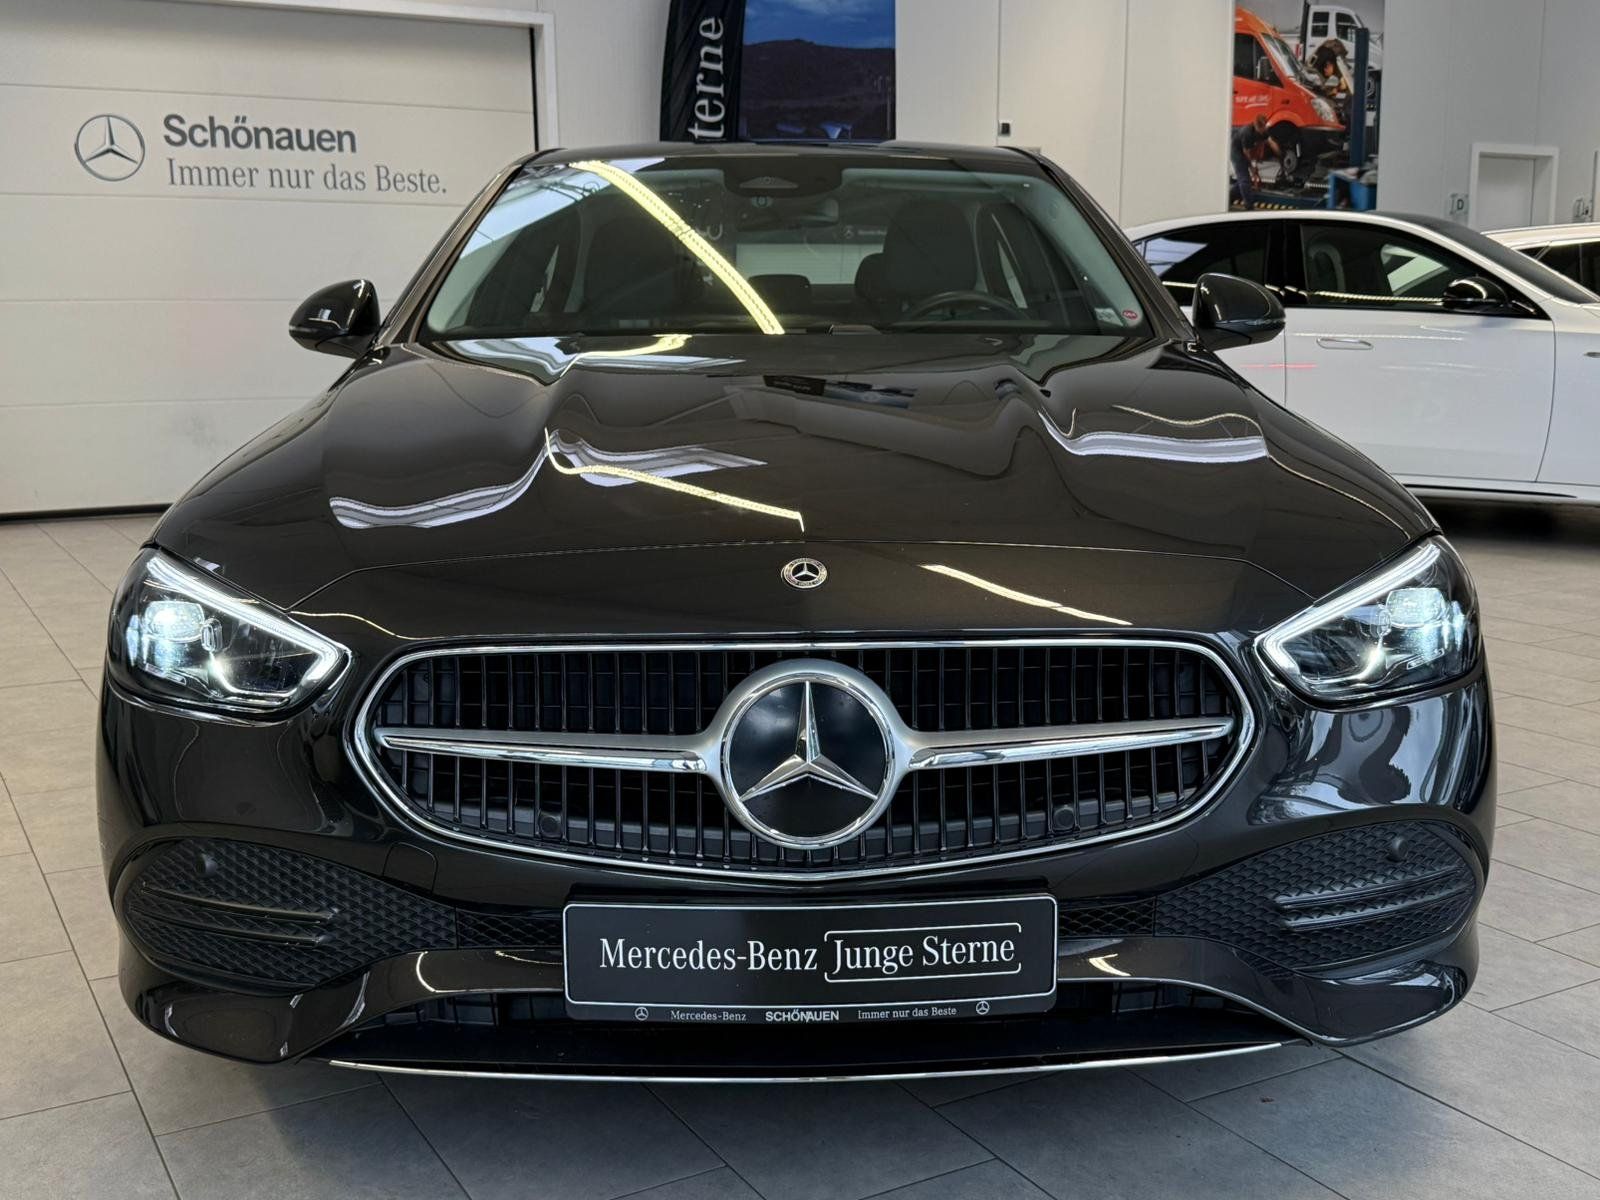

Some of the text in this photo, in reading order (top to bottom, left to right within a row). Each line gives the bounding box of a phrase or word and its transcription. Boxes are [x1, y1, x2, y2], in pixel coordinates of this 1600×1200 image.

[688, 16, 725, 139] terne
[163, 113, 356, 153] Schönauen
[167, 158, 448, 194] Immer nur das Beste.
[600, 935, 1016, 974] Mercedes-Benz Junge Sterne
[670, 1006, 957, 1022] Mercedes-Benz SCHÖNAUEN Immer nur das Beste
